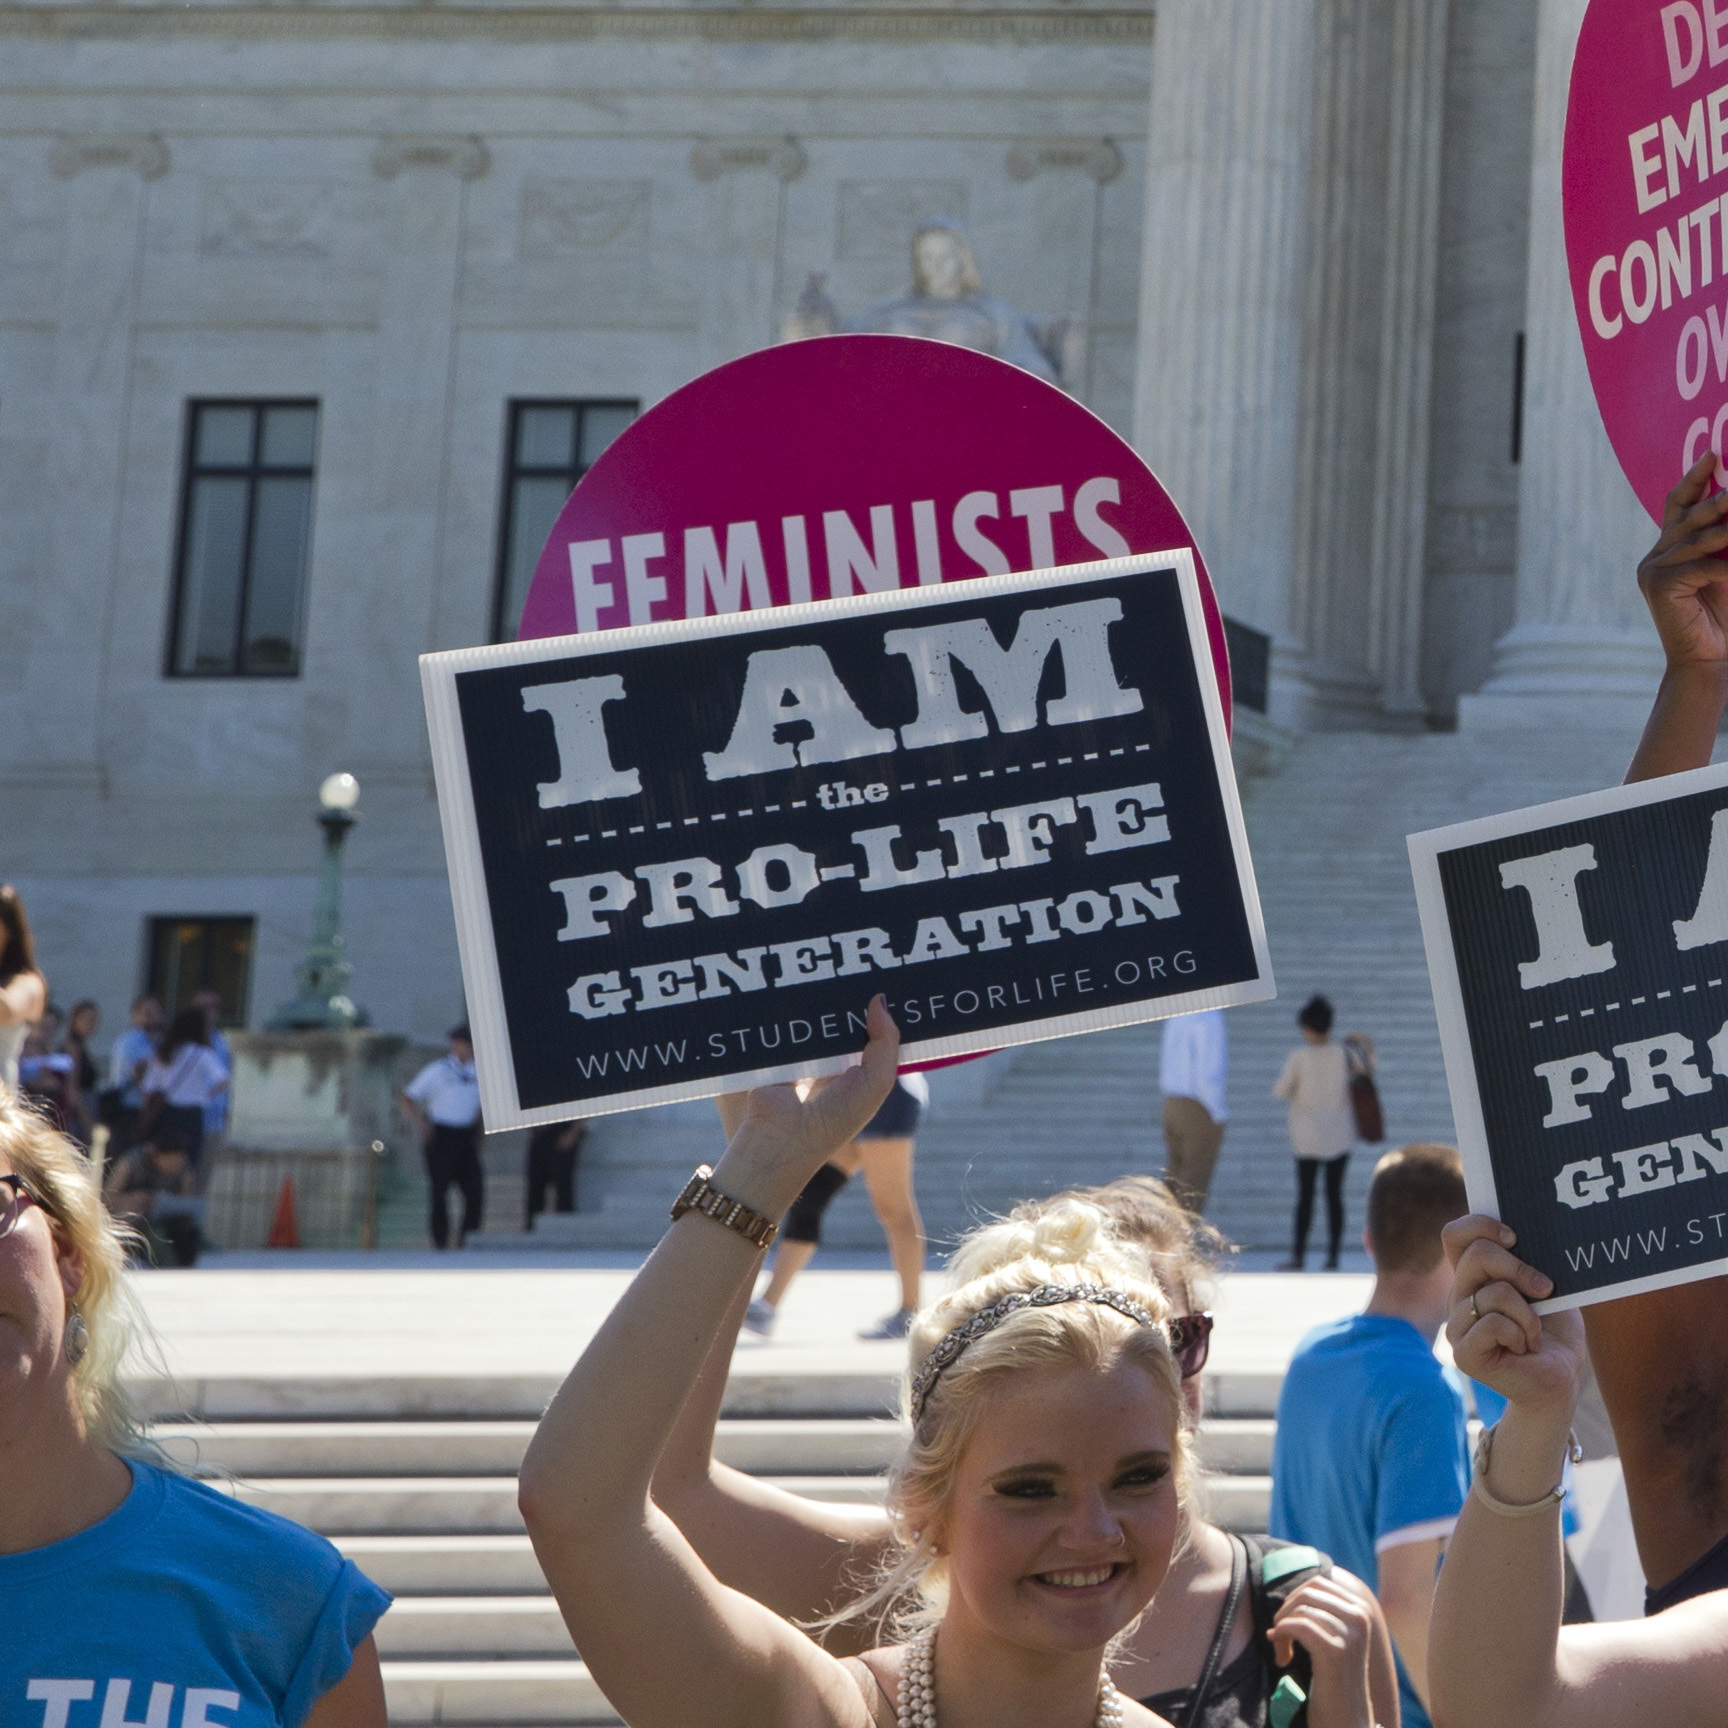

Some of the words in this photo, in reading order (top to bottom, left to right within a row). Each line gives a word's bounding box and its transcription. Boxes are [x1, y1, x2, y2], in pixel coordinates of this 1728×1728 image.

[567, 476, 1131, 634] FEMINISTS
[521, 673, 644, 809] I
[703, 597, 1144, 783] AM
[549, 783, 1172, 943] PRO-LIFE
[818, 774, 890, 812] the
[567, 874, 1184, 1022] GENERATION
[1497, 842, 1615, 991] I
[576, 947, 1199, 1082] WWW.STUDENSFORLIFE.ORG
